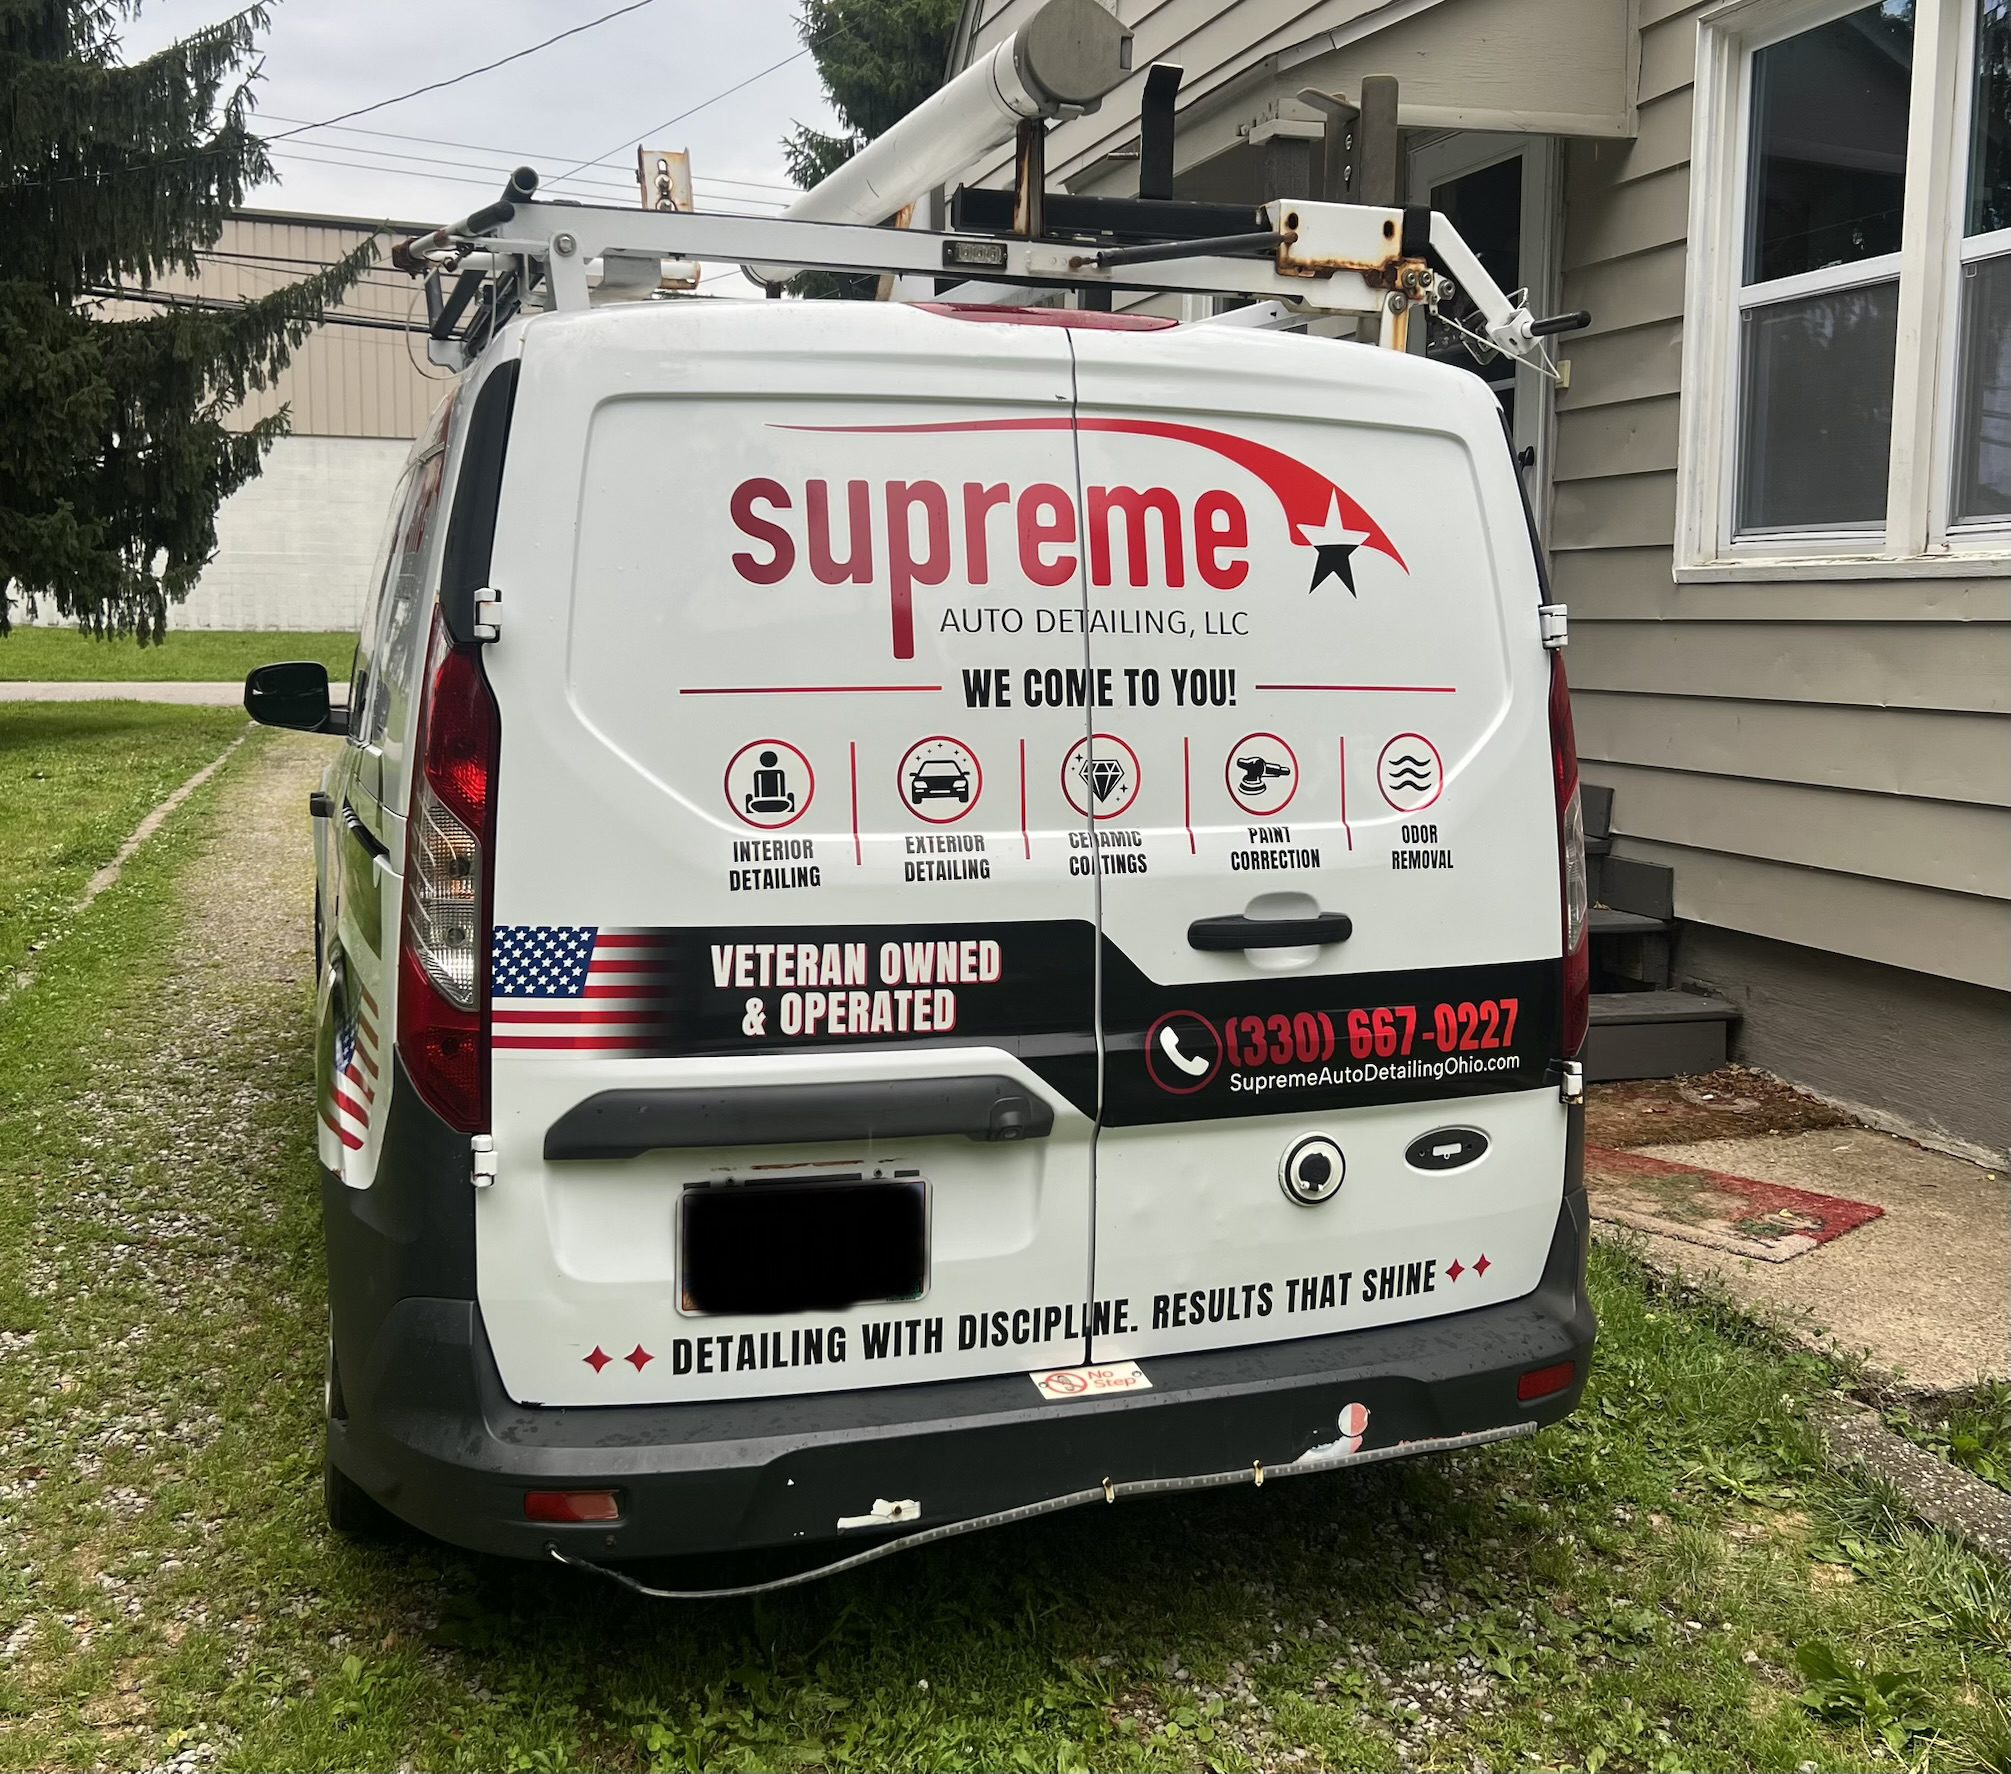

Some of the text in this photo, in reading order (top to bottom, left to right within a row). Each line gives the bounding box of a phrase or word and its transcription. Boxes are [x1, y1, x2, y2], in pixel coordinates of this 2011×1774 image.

[730, 477, 1249, 660] supreme
[940, 608, 1250, 639] AUTO DETAILING, LLC
[962, 668, 1238, 709] WE COME TO YOU!
[904, 834, 986, 855] EXTERIOR
[1248, 826, 1292, 845] PAINT
[1401, 824, 1439, 845] ODOR
[733, 838, 815, 863] INTERIOR
[1230, 848, 1321, 872] CORRECTION
[1391, 849, 1454, 871] REMOVAL
[729, 866, 822, 892] DETAILING
[904, 858, 991, 883] DETAILING
[710, 940, 1002, 989] VETERAN OWNED
[741, 988, 957, 1037] & OPERATED
[1224, 998, 1519, 1068] (330) 667-0227
[1230, 1053, 1520, 1095] SupremeAutoDetailingOhio.com
[672, 1258, 1438, 1376] DETAILING WITH DISCIPLINE. RESULTS THAT SHINE
[1088, 1369, 1114, 1380] No
[1094, 1376, 1137, 1388] Step
